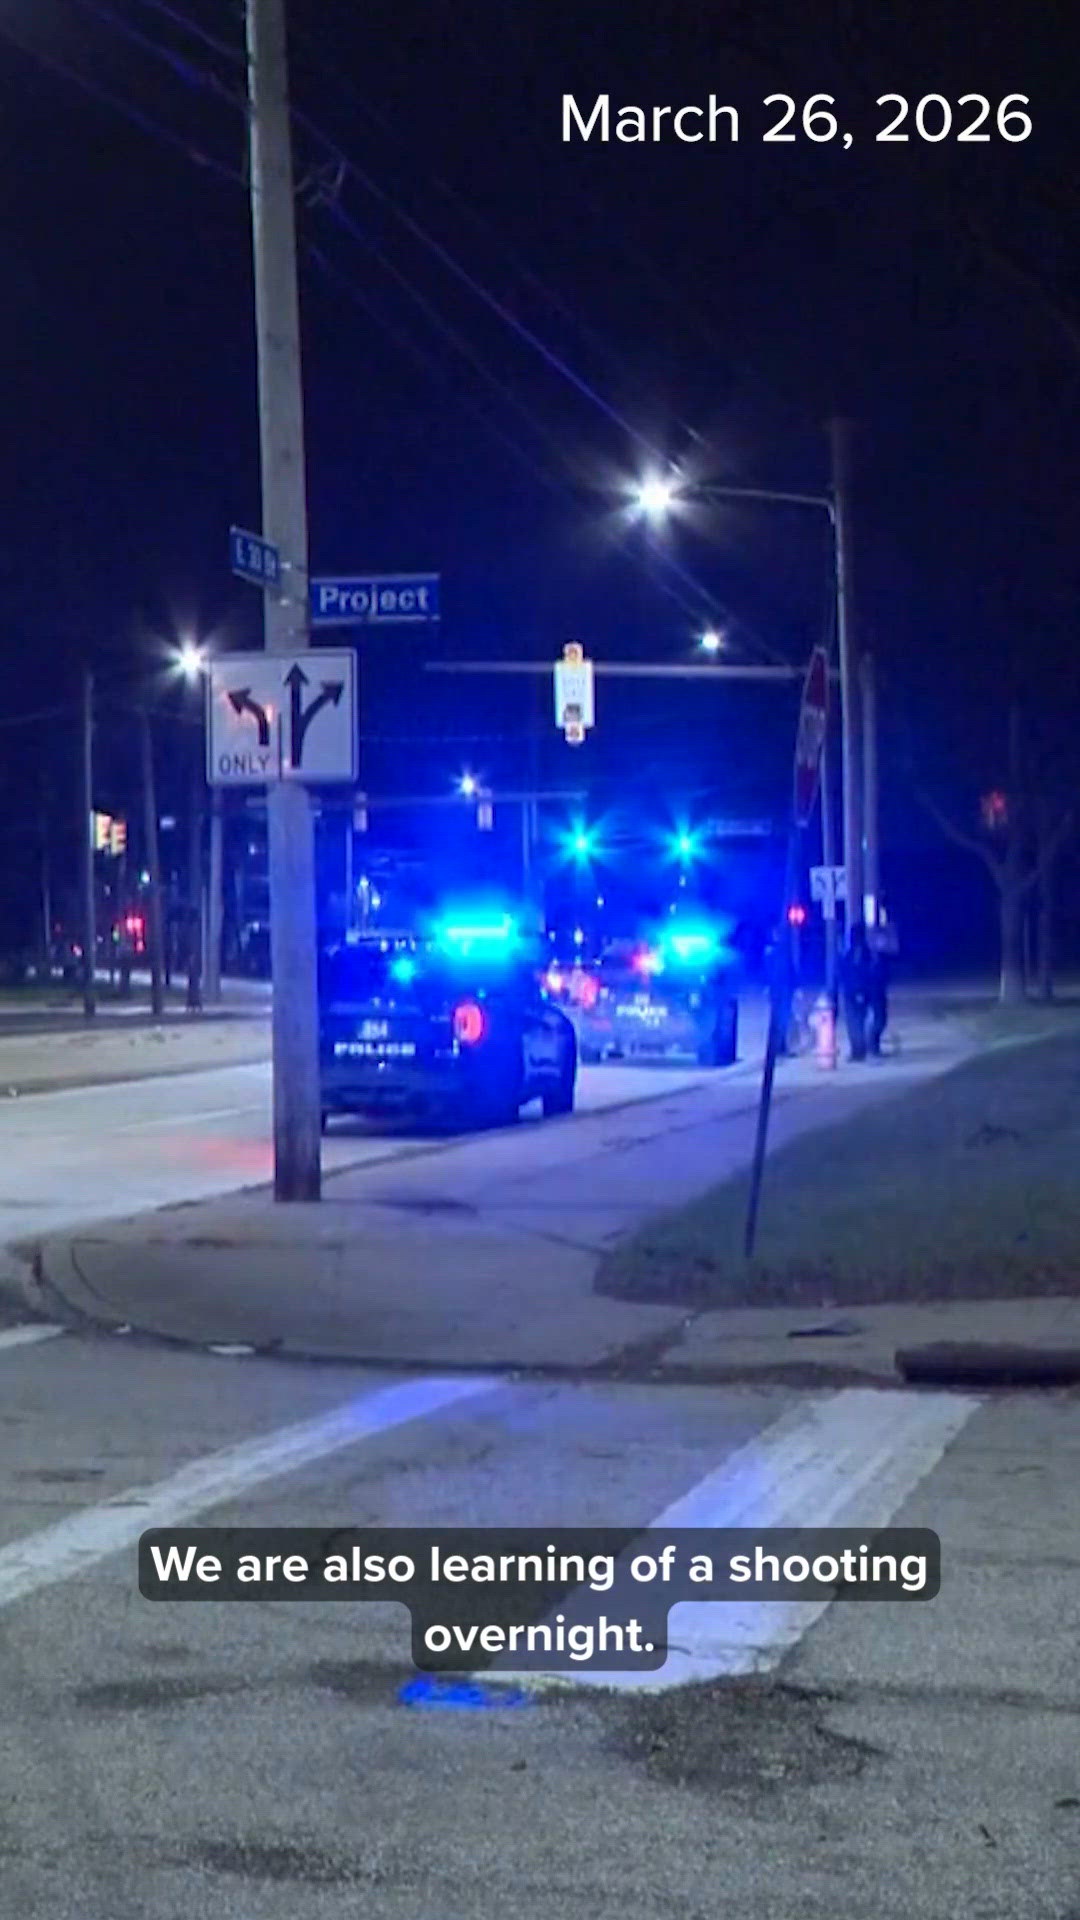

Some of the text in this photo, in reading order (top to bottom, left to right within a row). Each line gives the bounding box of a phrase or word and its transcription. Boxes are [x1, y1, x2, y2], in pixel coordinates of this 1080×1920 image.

[319, 583, 428, 617] Project
[219, 752, 270, 775] ONLY
[334, 1042, 416, 1057] POLICE
